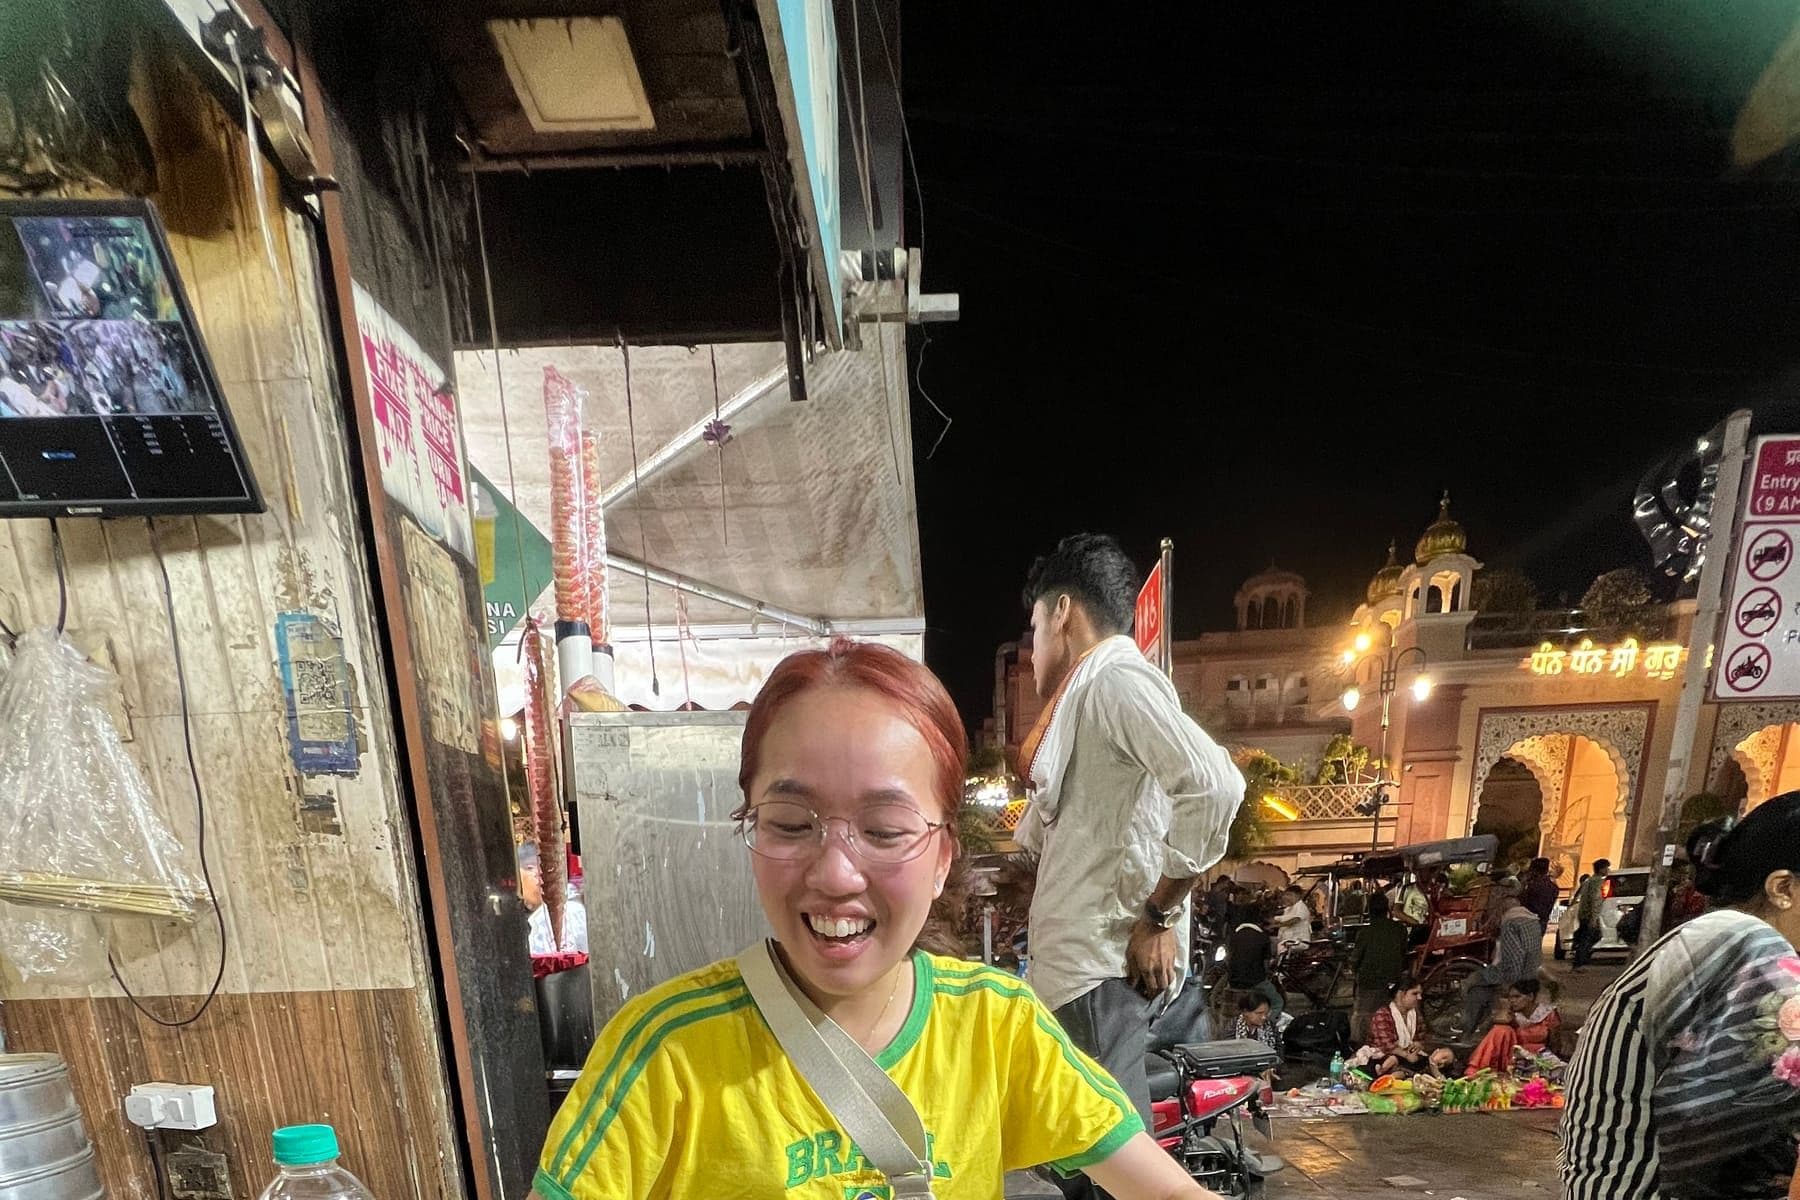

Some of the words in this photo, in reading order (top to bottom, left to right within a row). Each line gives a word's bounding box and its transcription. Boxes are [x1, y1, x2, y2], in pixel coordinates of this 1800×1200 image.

[375, 347, 409, 407] FIXE
[1760, 474, 1800, 491] Entry
[785, 1130, 953, 1189] BRAL
